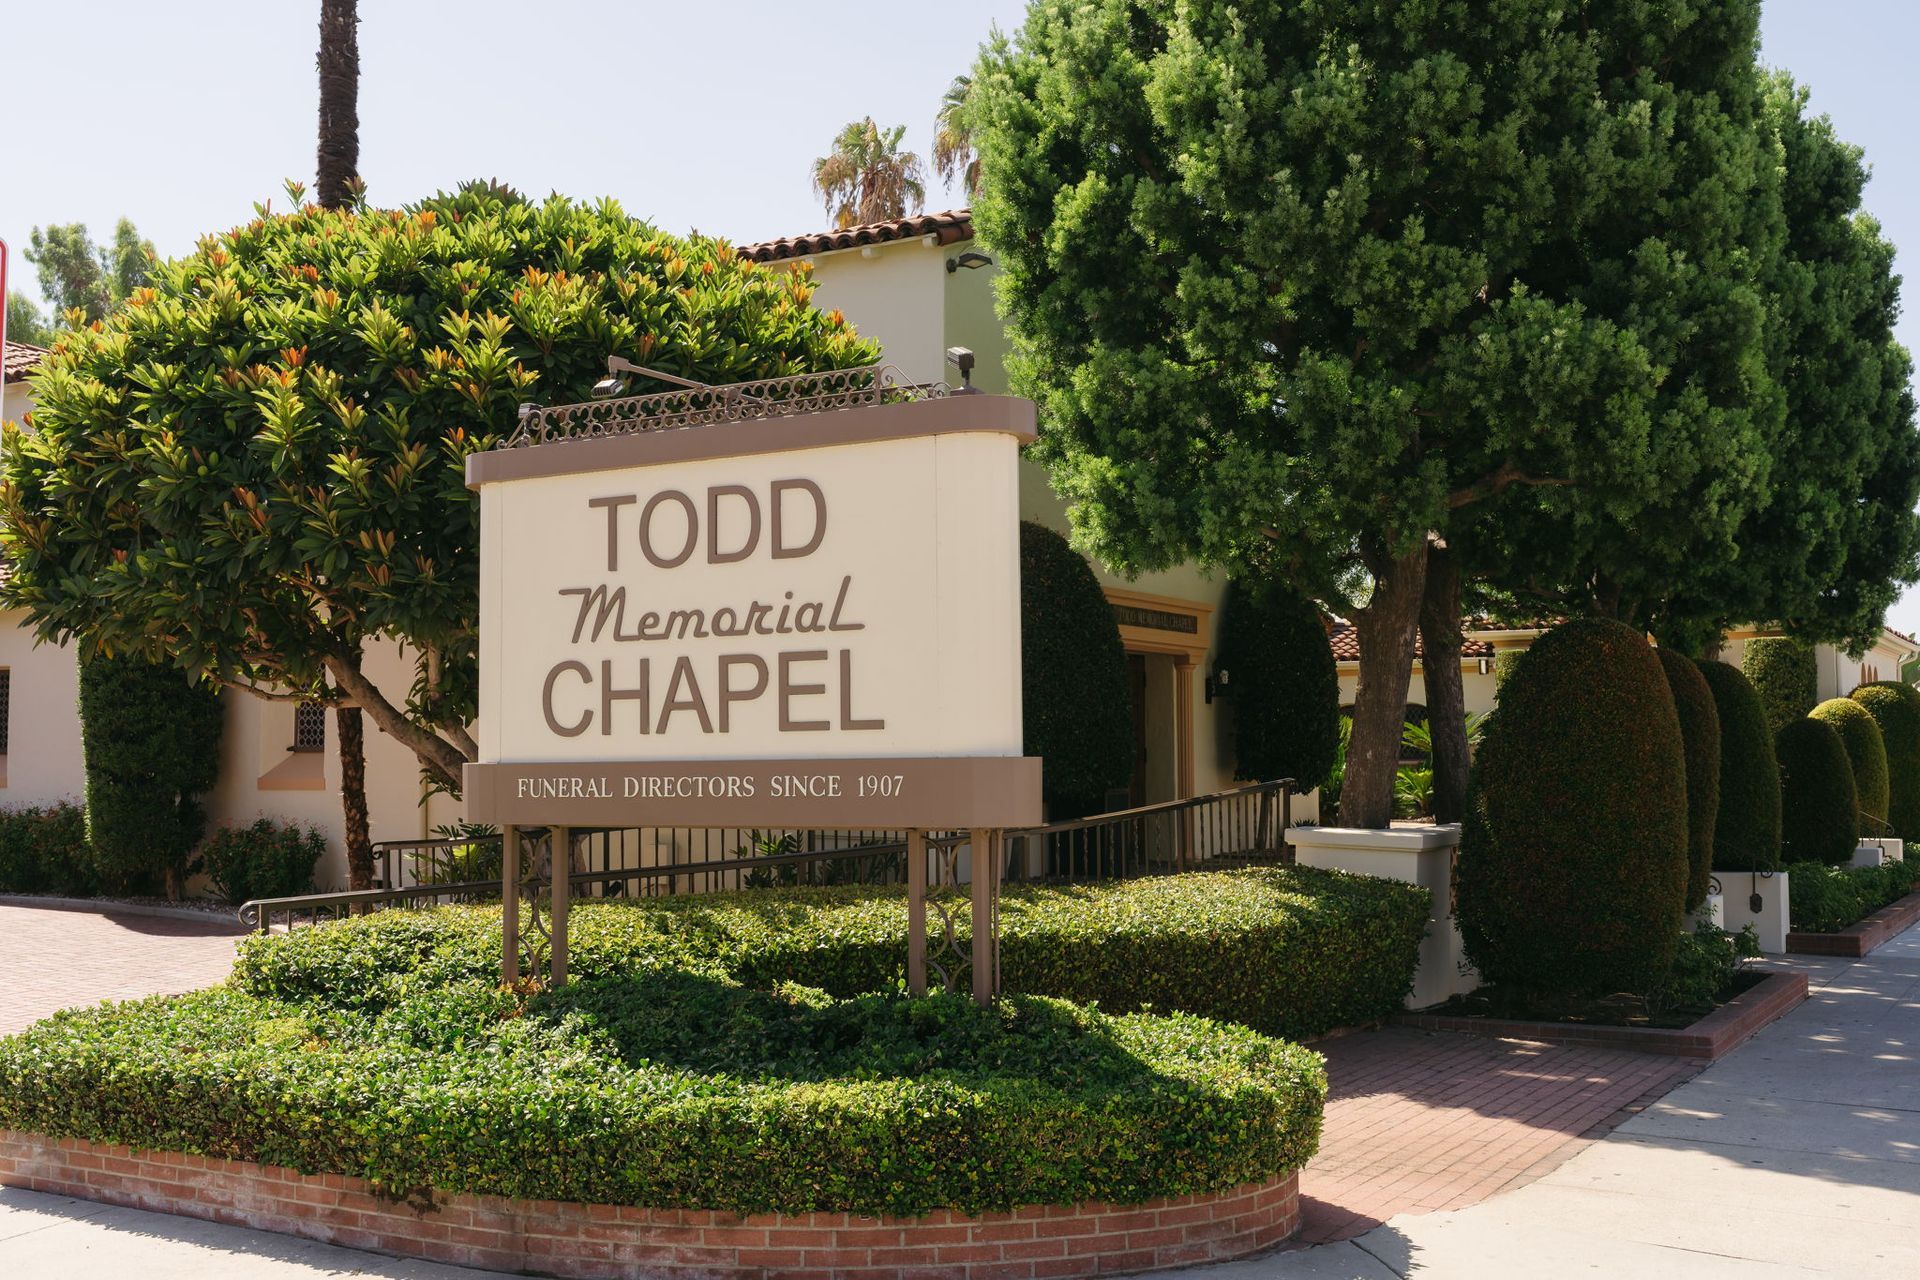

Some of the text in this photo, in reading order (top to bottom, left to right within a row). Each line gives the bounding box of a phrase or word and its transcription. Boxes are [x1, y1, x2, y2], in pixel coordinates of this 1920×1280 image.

[588, 477, 828, 572] TODD
[557, 574, 866, 645] Memorial
[541, 649, 886, 738] CHAPEL
[517, 774, 904, 799] FUNERAL DIRECTORS SINCE 1907
